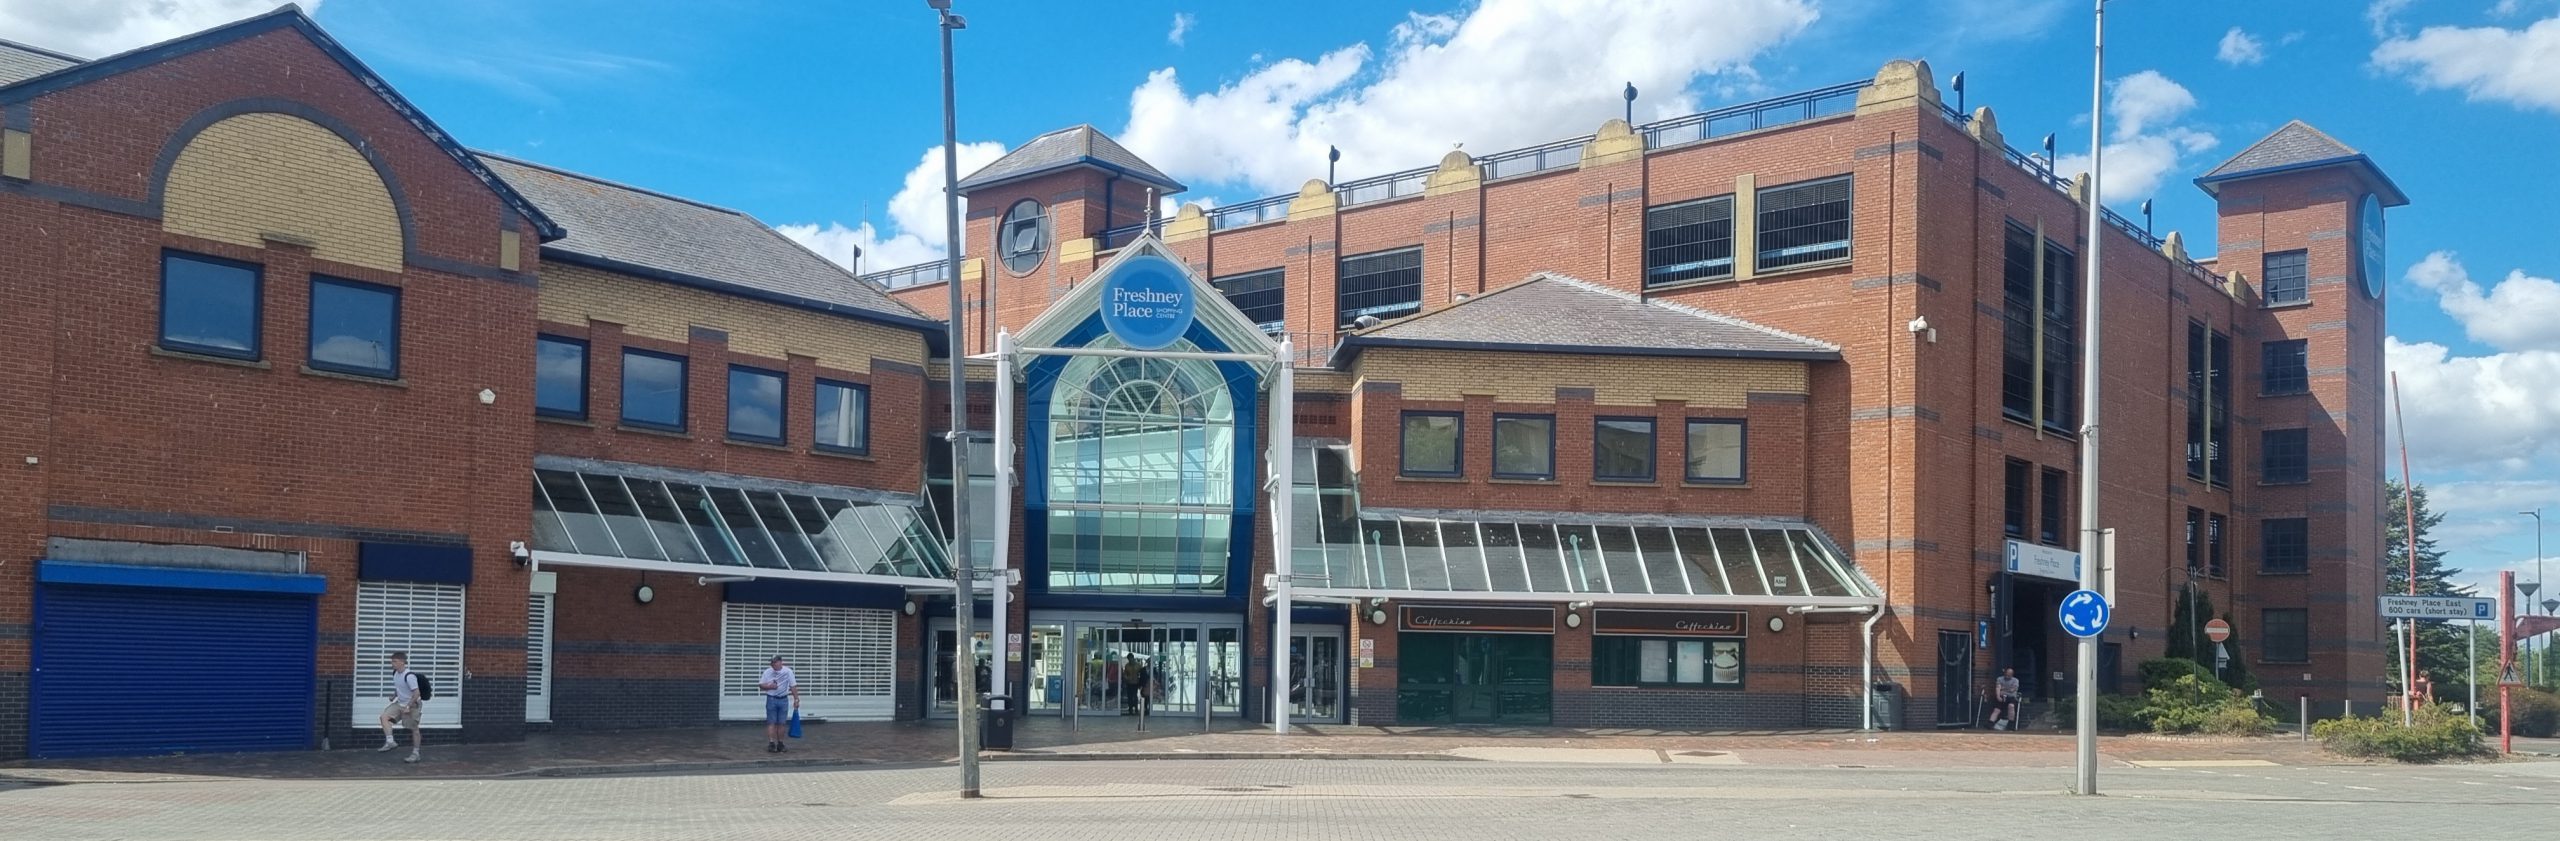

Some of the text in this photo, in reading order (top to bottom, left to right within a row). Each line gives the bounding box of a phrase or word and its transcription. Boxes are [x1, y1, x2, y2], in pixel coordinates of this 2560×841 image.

[1113, 287, 1183, 307] Freshney
[1113, 302, 1153, 318] Place
[2387, 598, 2417, 607] Freshney
[2422, 599, 2440, 607] Place
